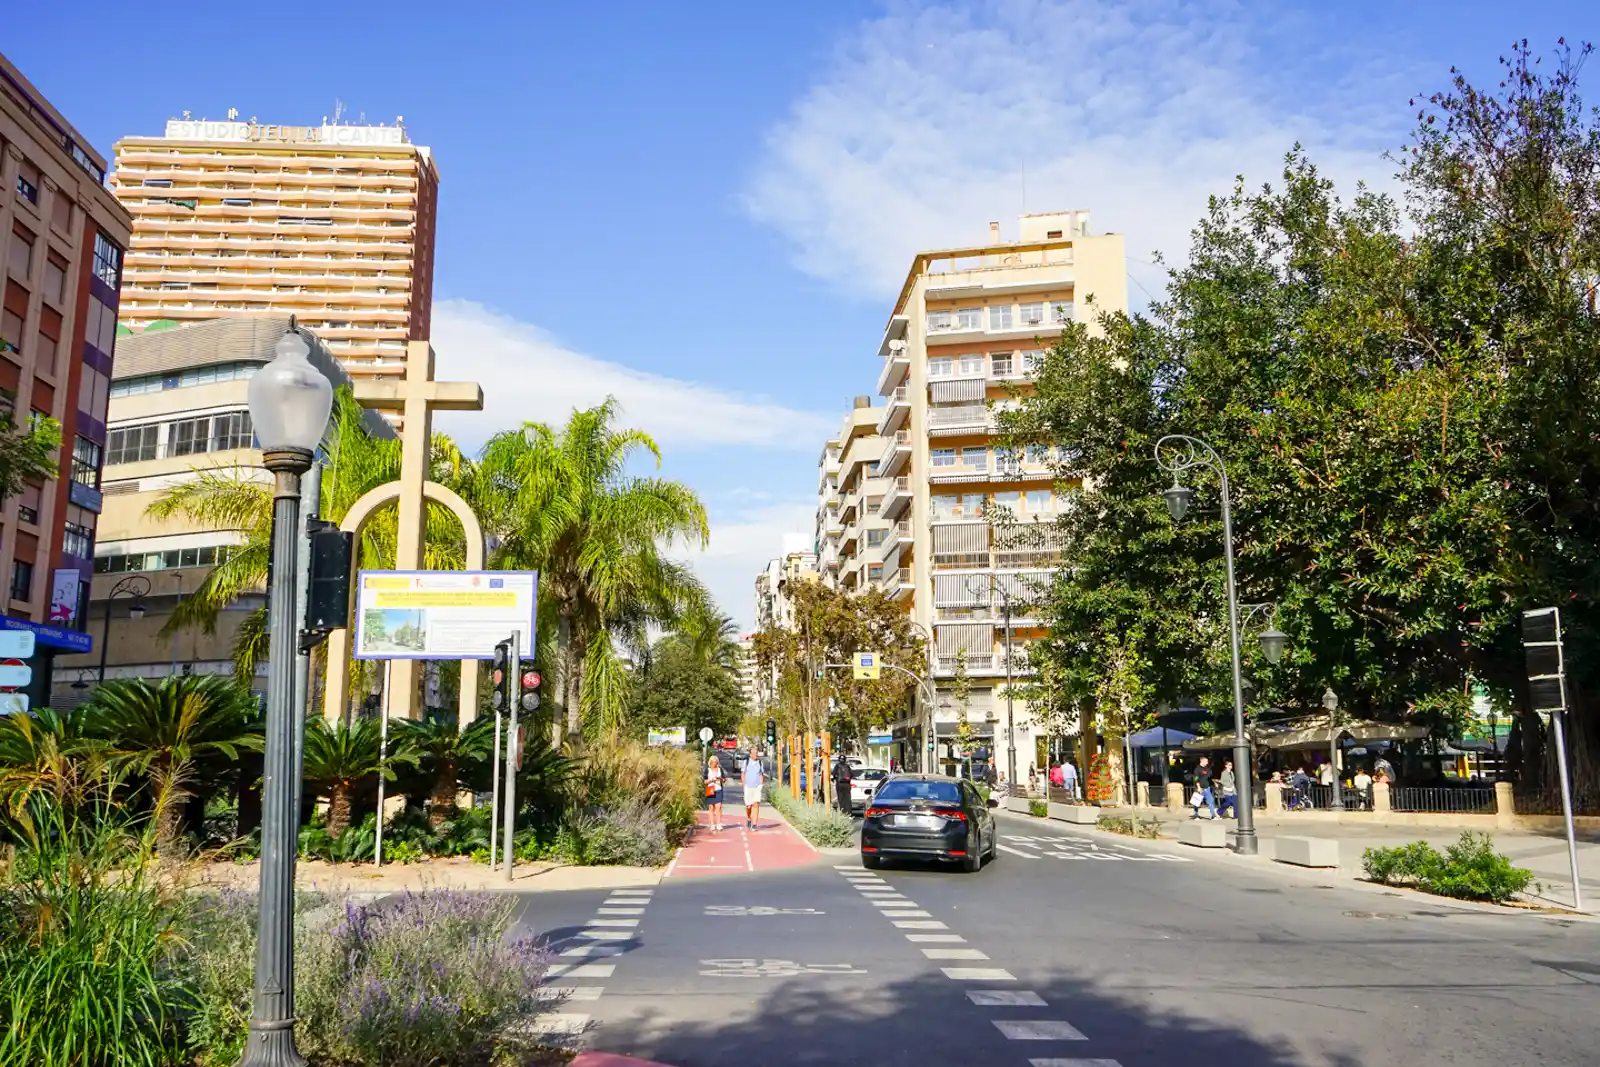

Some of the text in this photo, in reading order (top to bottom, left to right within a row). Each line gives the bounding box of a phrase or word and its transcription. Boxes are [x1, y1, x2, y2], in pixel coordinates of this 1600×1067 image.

[304, 125, 402, 144] ALICANTE
[1000, 835, 1093, 843] BUS
[1011, 842, 1140, 851] TAXI
[1043, 851, 1194, 862] SOLO
